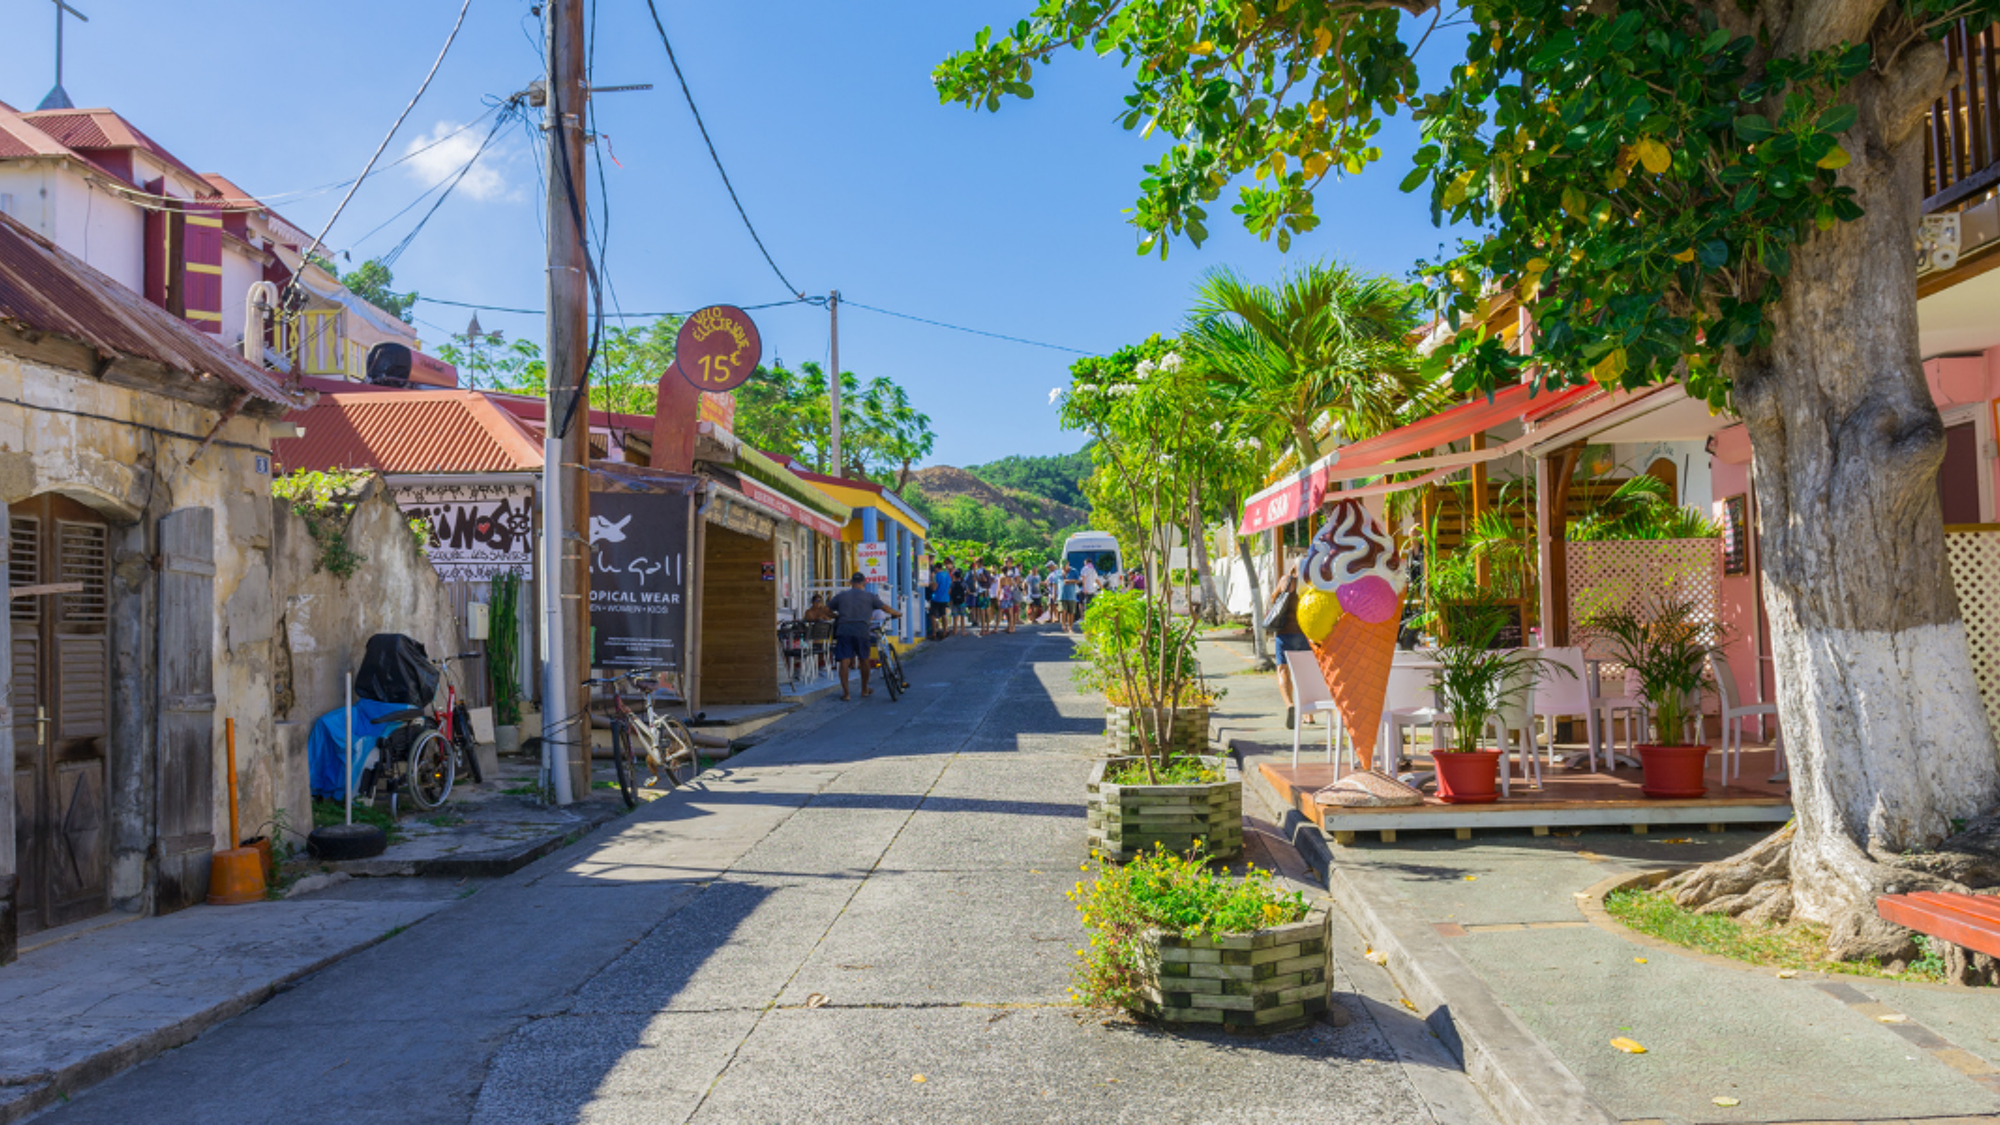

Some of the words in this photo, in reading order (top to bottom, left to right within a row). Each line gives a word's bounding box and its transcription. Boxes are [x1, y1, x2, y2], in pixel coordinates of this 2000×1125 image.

[698, 350, 741, 383] 15€
[589, 590, 637, 603] OPICAL
[640, 592, 681, 605] WEAR
